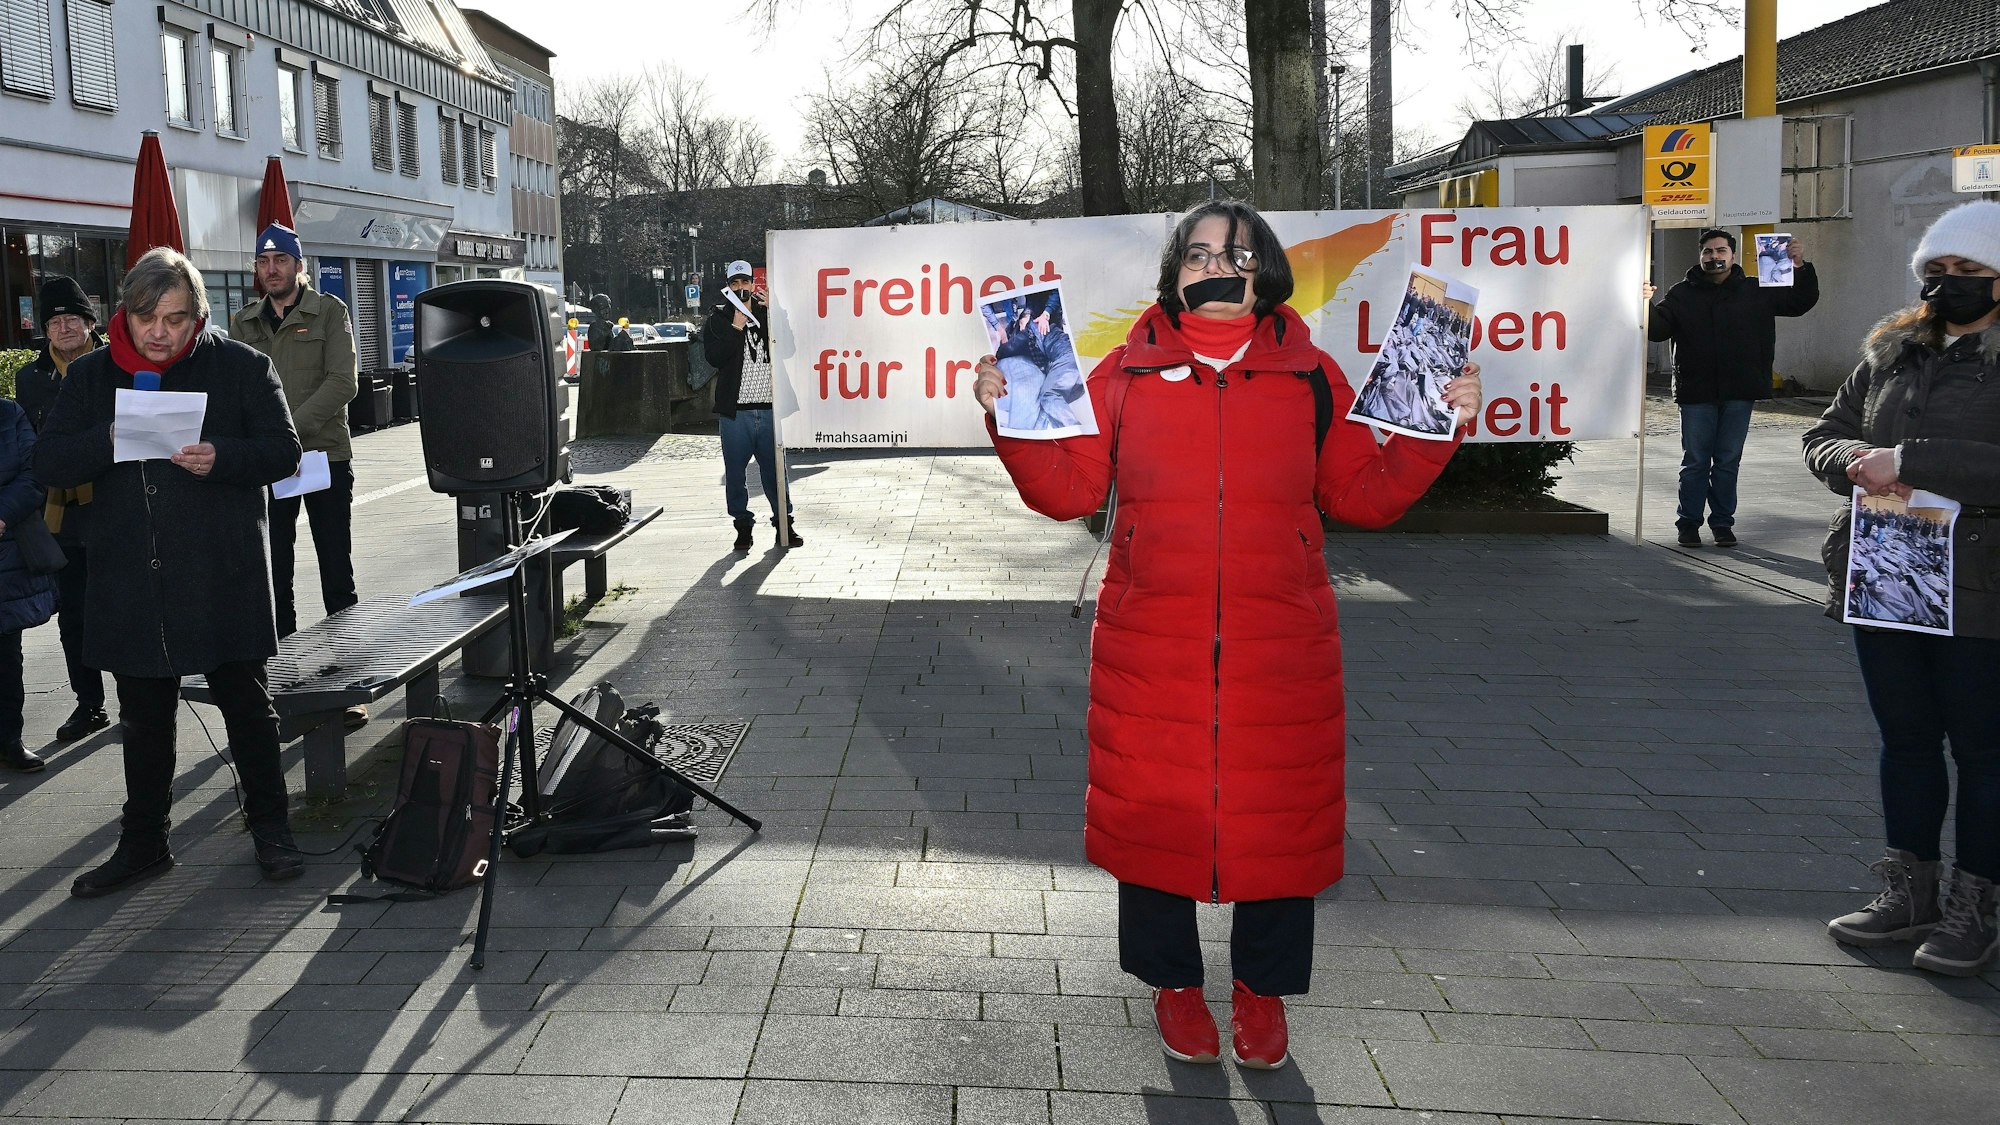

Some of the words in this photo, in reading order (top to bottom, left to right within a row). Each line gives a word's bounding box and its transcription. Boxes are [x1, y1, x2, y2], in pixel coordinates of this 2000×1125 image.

[1660, 193, 1696, 202] DHL
[1657, 208, 1706, 216] Geldautomat
[1420, 213, 1570, 268] Frau
[475, 242, 487, 258] SHOP
[688, 287, 696, 298] P
[1357, 300, 1567, 353] Len
[813, 349, 903, 400] für
[925, 346, 981, 399] Ir
[814, 430, 908, 445] #mahsaamini
